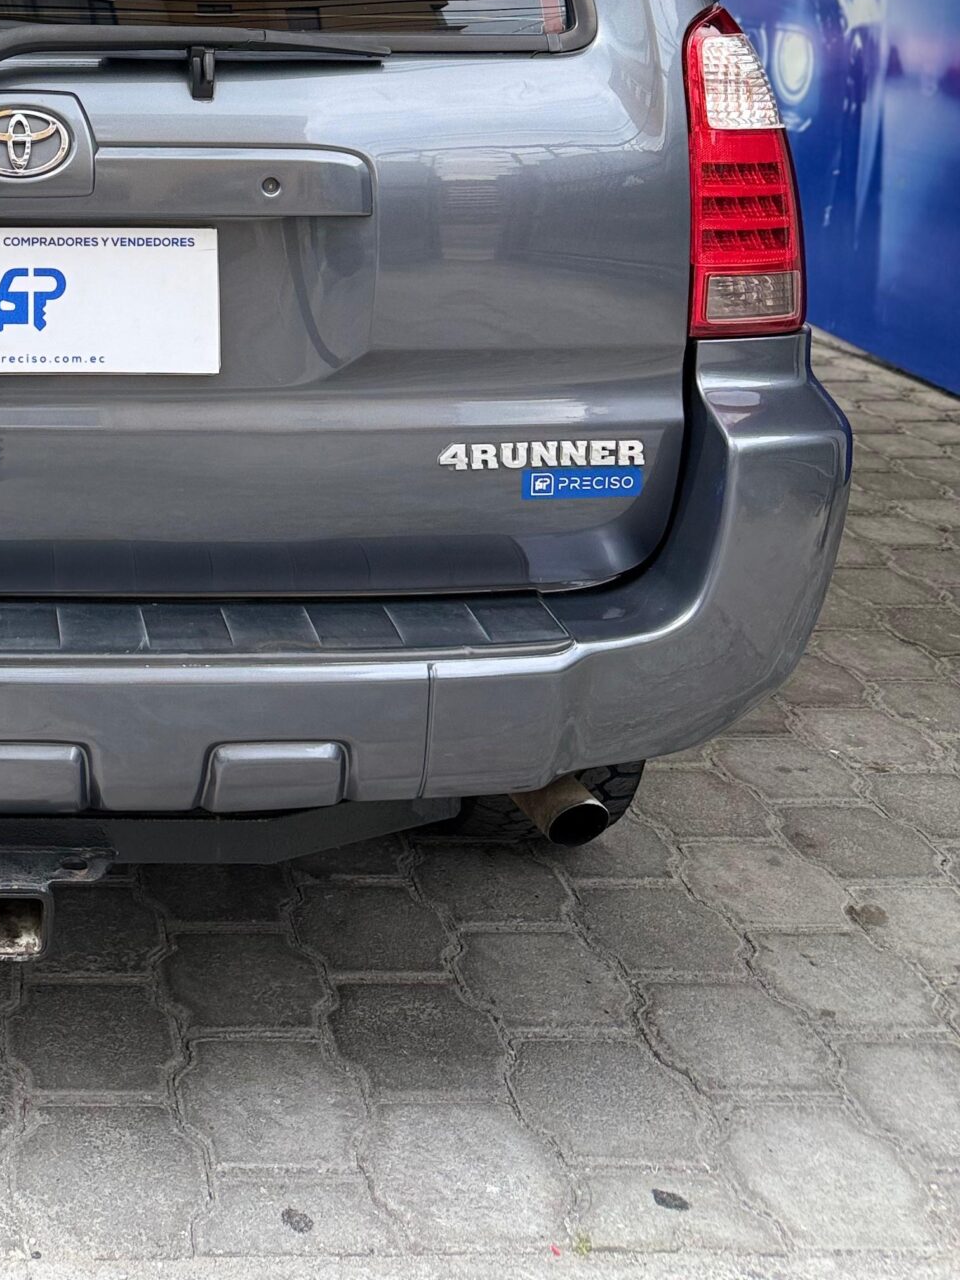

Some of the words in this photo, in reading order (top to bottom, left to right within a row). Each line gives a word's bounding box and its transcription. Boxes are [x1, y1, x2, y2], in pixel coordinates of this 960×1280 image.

[3, 236, 99, 248] COMPRADORES
[101, 236, 110, 248] Y
[111, 236, 195, 248] VENDEDORES
[438, 439, 646, 470] 4RUNNER
[558, 476, 634, 490] PRECISO
